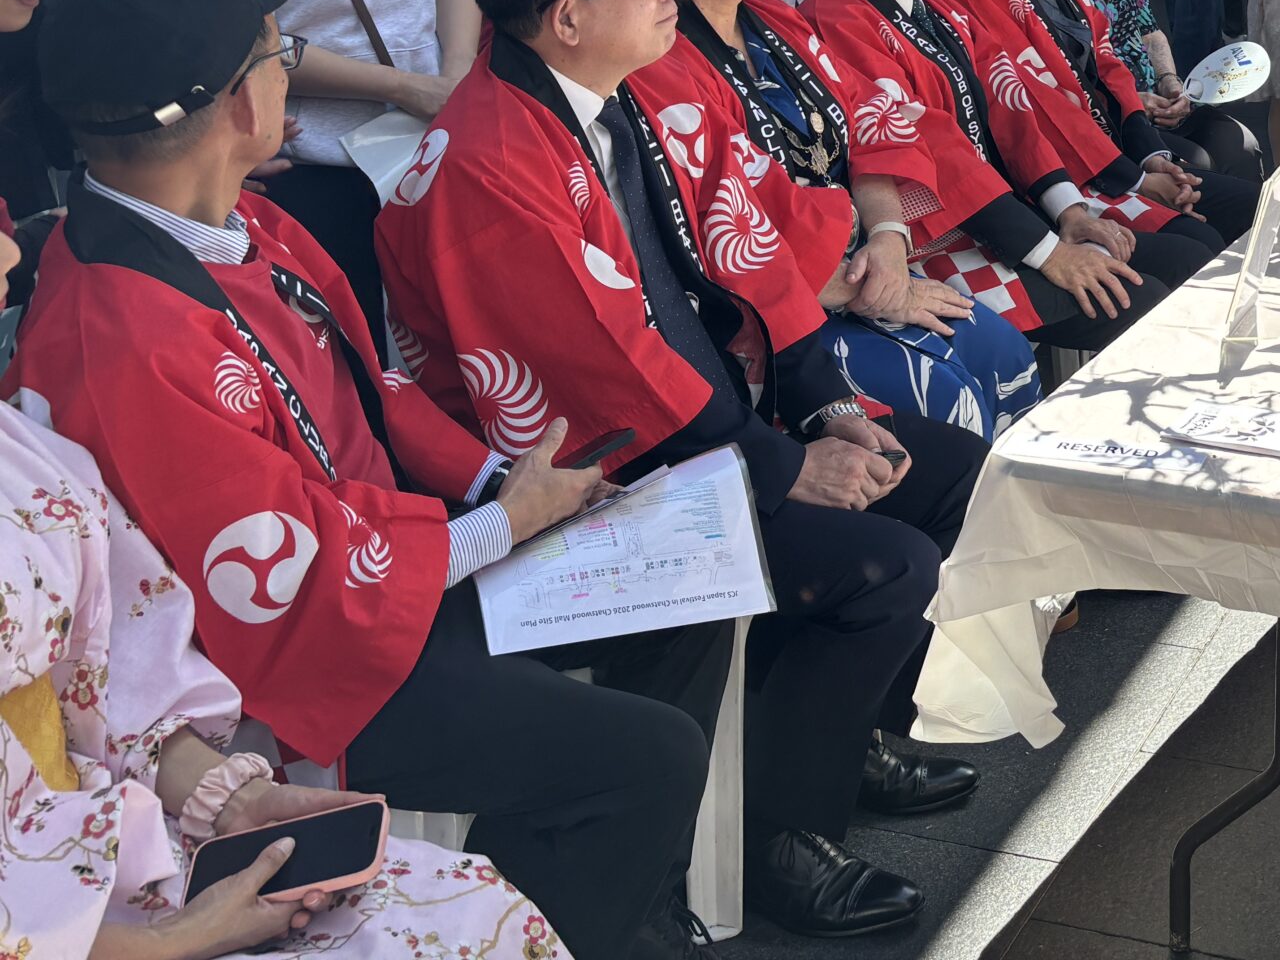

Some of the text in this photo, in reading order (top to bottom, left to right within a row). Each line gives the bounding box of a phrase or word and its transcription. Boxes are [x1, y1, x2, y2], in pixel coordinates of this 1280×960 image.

[893, 10, 937, 54] JAPAN
[937, 53, 968, 94] CLUB
[962, 94, 974, 119] OF
[724, 64, 767, 121] JAPAN
[225, 308, 287, 399] JAPAN
[289, 395, 329, 468] CLUB
[1056, 441, 1160, 460] RESERVED
[680, 594, 706, 605] Festival
[706, 591, 726, 600] Japan
[613, 606, 631, 614] 2026
[632, 599, 671, 612] Chatswood
[554, 614, 571, 623] Mall
[572, 608, 612, 619] Chatswood
[520, 619, 537, 627] Plan
[538, 617, 553, 625] Site
